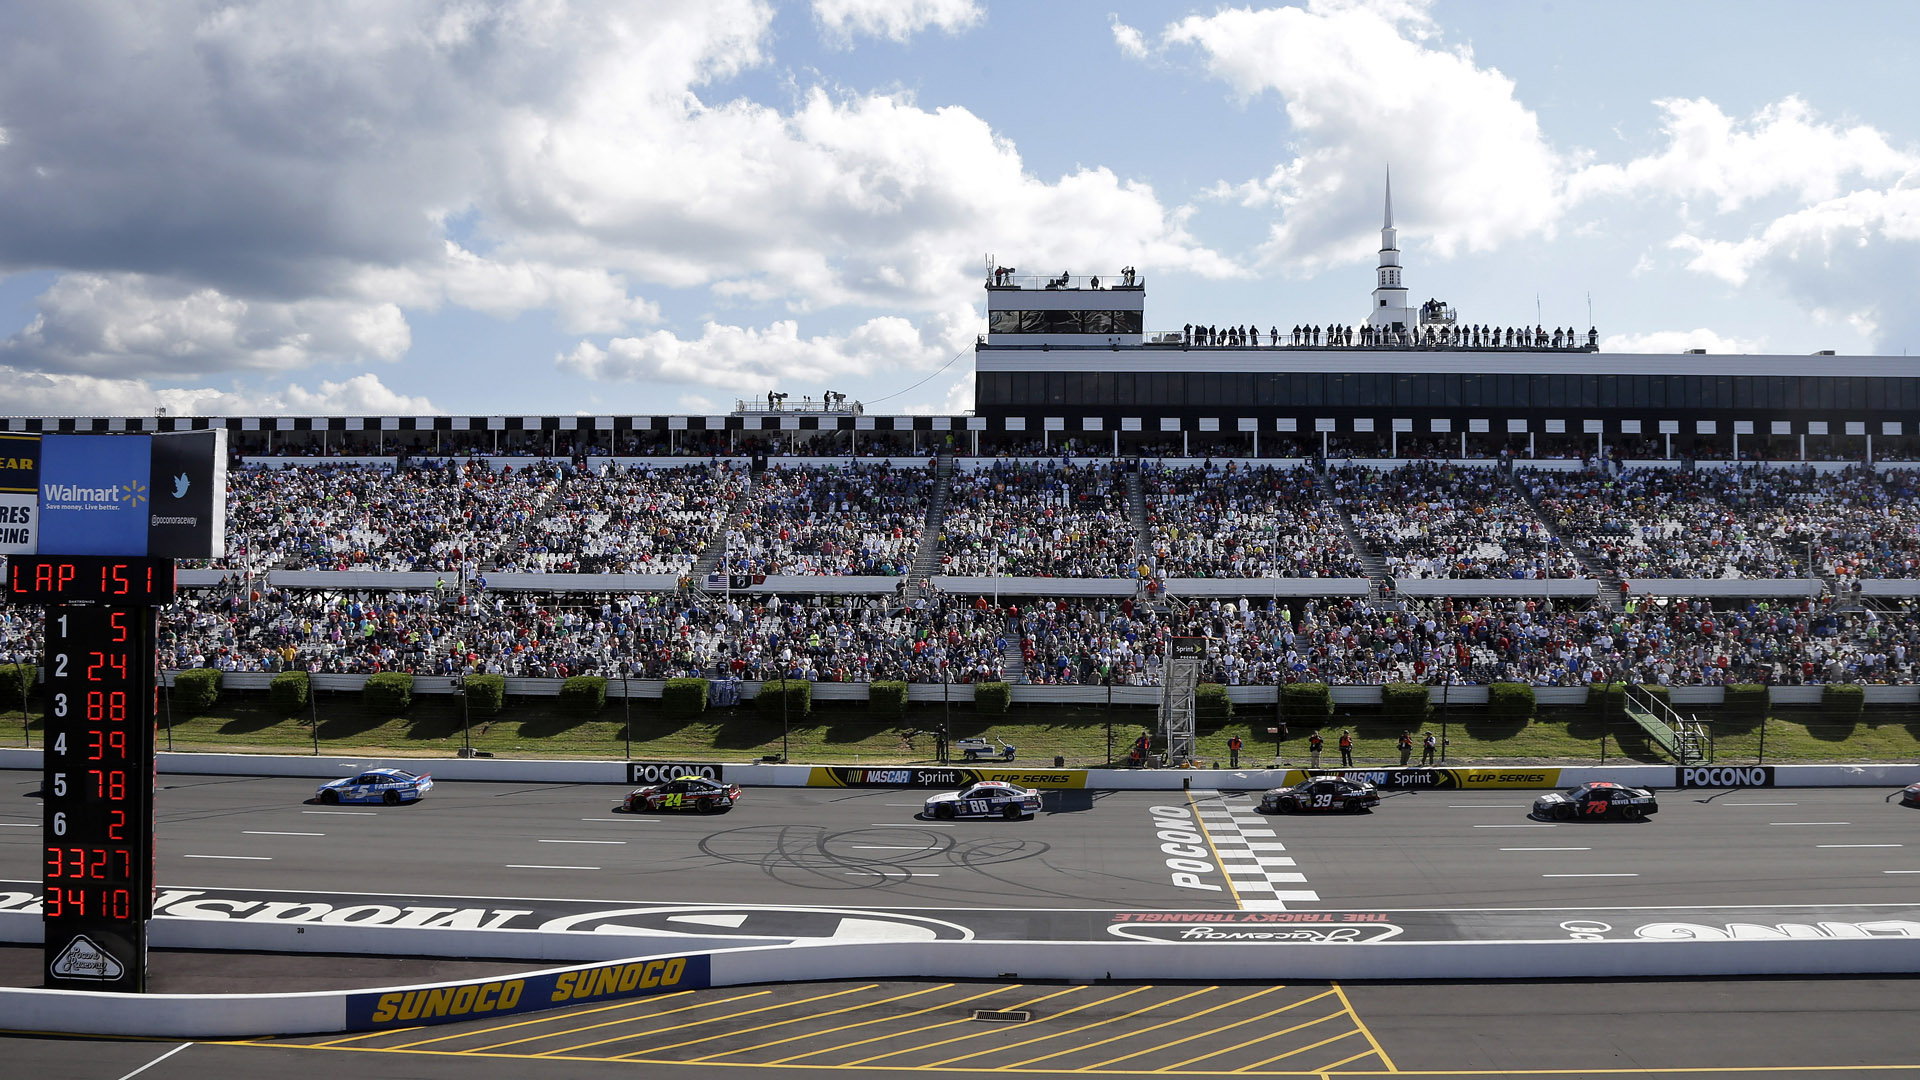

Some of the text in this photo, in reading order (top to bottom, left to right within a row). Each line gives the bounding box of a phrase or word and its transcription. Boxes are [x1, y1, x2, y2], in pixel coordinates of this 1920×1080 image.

[44, 484, 119, 502] Walmart
[152, 514, 198, 527] @poconoraceway
[13, 564, 152, 595] LAP 151
[57, 612, 127, 642] 1 5
[1176, 645, 1194, 654] Sprint
[55, 651, 127, 681] 2 24
[54, 691, 126, 721] 3 88
[54, 730, 126, 760] 4 39
[633, 765, 715, 783] POCONO
[866, 770, 909, 783] NASCAR
[917, 771, 955, 787] Sprint
[1022, 775, 1070, 783] SERIES
[1394, 772, 1431, 787] Sprint
[1467, 774, 1496, 783] CUP
[1497, 774, 1545, 783] SERIES
[1683, 767, 1766, 786] POCONO
[54, 770, 126, 801] 5 78
[355, 784, 370, 799] 5
[664, 793, 683, 807] 24
[969, 800, 989, 813] 88
[1313, 794, 1333, 808] 39
[1586, 801, 1608, 814] 78
[54, 810, 125, 840] 6 2
[1149, 806, 1222, 891] POCONO
[1111, 913, 1390, 922] THE TRICKY TRIANGLE
[551, 955, 688, 1002] SUNOCO
[372, 979, 526, 1023] SUNOCO
